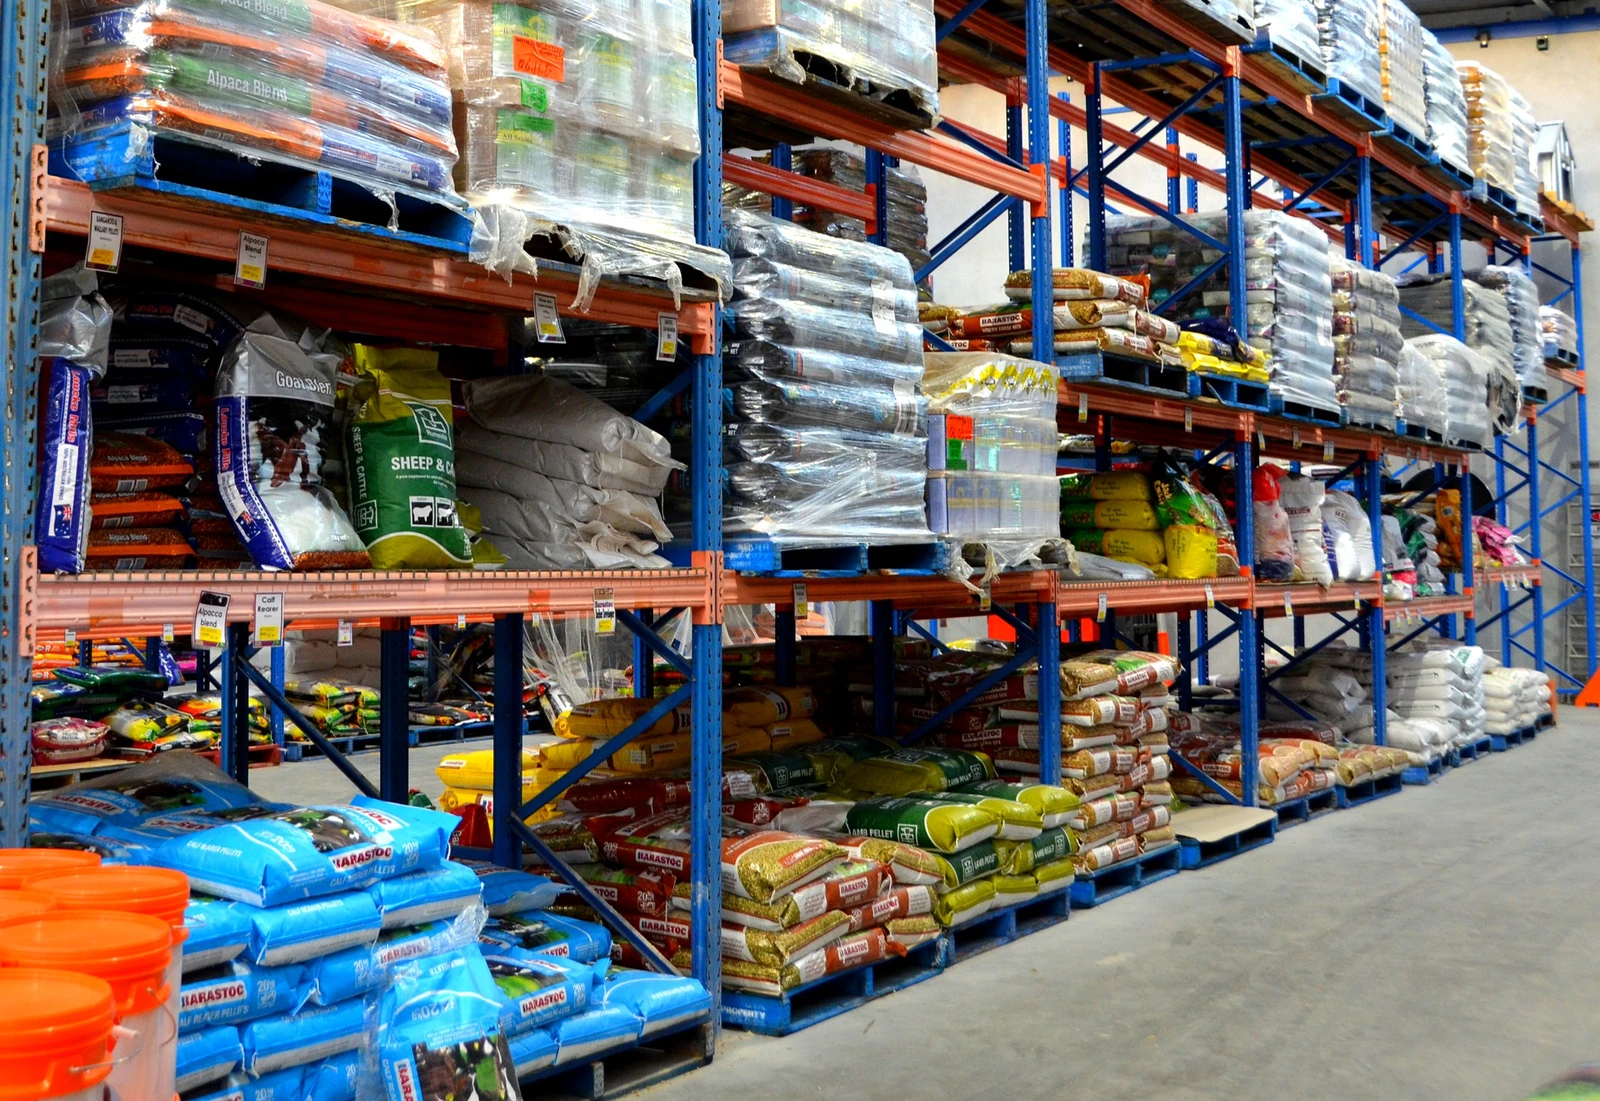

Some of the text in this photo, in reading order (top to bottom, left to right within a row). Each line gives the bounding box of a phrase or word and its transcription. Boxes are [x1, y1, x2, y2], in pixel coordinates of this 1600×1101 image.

[207, 69, 288, 101] Alpaca Blend
[243, 235, 265, 246] Alpaca
[245, 244, 261, 255] Blend
[981, 314, 1020, 325] BARASTOC
[304, 377, 333, 395] Blen
[67, 370, 80, 443] Laucke Mills
[220, 407, 230, 446] Laucke
[221, 447, 231, 470] Mills
[352, 426, 367, 499] SHEEP & CATTLE
[391, 455, 456, 478] SHEEP & CA
[109, 533, 129, 541] Alpaca
[261, 596, 276, 604] Calf
[198, 607, 223, 618] Alpacca
[200, 618, 218, 628] blend
[852, 828, 893, 838] AMB PELLET
[186, 840, 201, 850] CALF
[219, 847, 243, 858] PELLETS
[332, 846, 392, 869] BARASTOC
[637, 852, 682, 867] BARASTOC
[596, 888, 616, 898] STOC
[641, 919, 687, 936] BARASTOC
[541, 945, 568, 957] ASTOC
[181, 983, 244, 1007] BARASTOC
[522, 987, 565, 1013] BARASTOC
[178, 1003, 250, 1028] ALF REARER PELLETS
[397, 1064, 414, 1101] BARA
